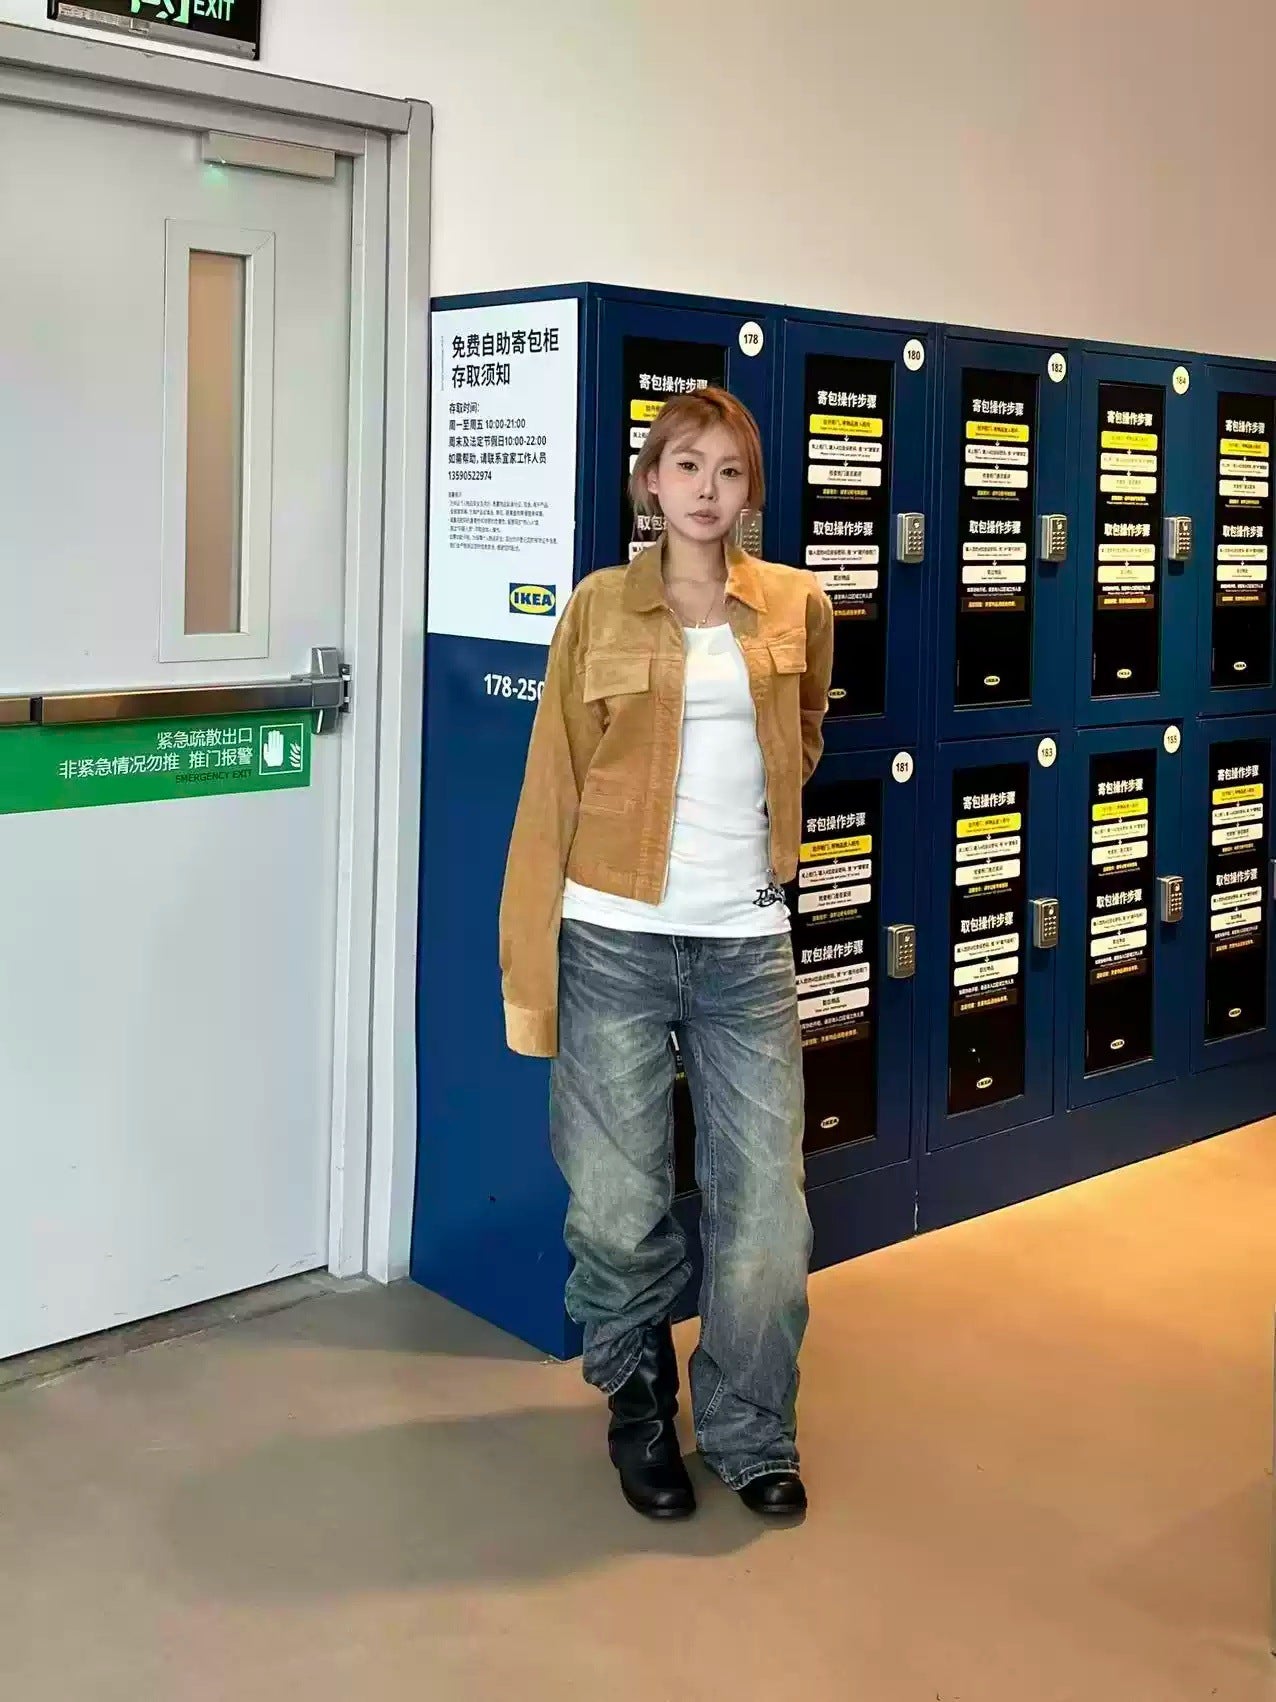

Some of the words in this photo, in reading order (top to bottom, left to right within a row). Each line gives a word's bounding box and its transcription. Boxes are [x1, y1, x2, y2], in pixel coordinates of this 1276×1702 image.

[193, 0, 235, 21] EXIT
[452, 327, 559, 359] 免费自助寄包柜
[743, 334, 759, 345] 178
[907, 350, 921, 361] 180
[451, 362, 510, 388] 存取须知
[1051, 362, 1063, 373] 182
[817, 389, 877, 409] 寄包操作步骤
[449, 402, 480, 414] 存取时间:
[972, 398, 1024, 417] 寄包操作步骤
[449, 419, 484, 430] 周一至周五
[485, 418, 526, 429] 10:00-21:00
[448, 470, 492, 480] 13590522974
[813, 520, 873, 536] 取包操作步骤
[969, 520, 1022, 535] 取包操作步骤
[513, 591, 553, 607] IKEA
[156, 727, 253, 750] 紧急疏散出口
[1041, 747, 1053, 757] 183
[58, 752, 180, 779] 非紧急情况勿推
[189, 747, 253, 769] 推门报警
[895, 762, 909, 772] 181
[176, 771, 230, 784] EMERGENCY
[232, 769, 253, 779] EXIT
[963, 790, 1016, 810] 寄包操作步骤
[806, 811, 867, 833] 寄包操作步骤
[960, 911, 1014, 934] 取包操作步骤
[801, 939, 864, 965] 取包操作步骤
